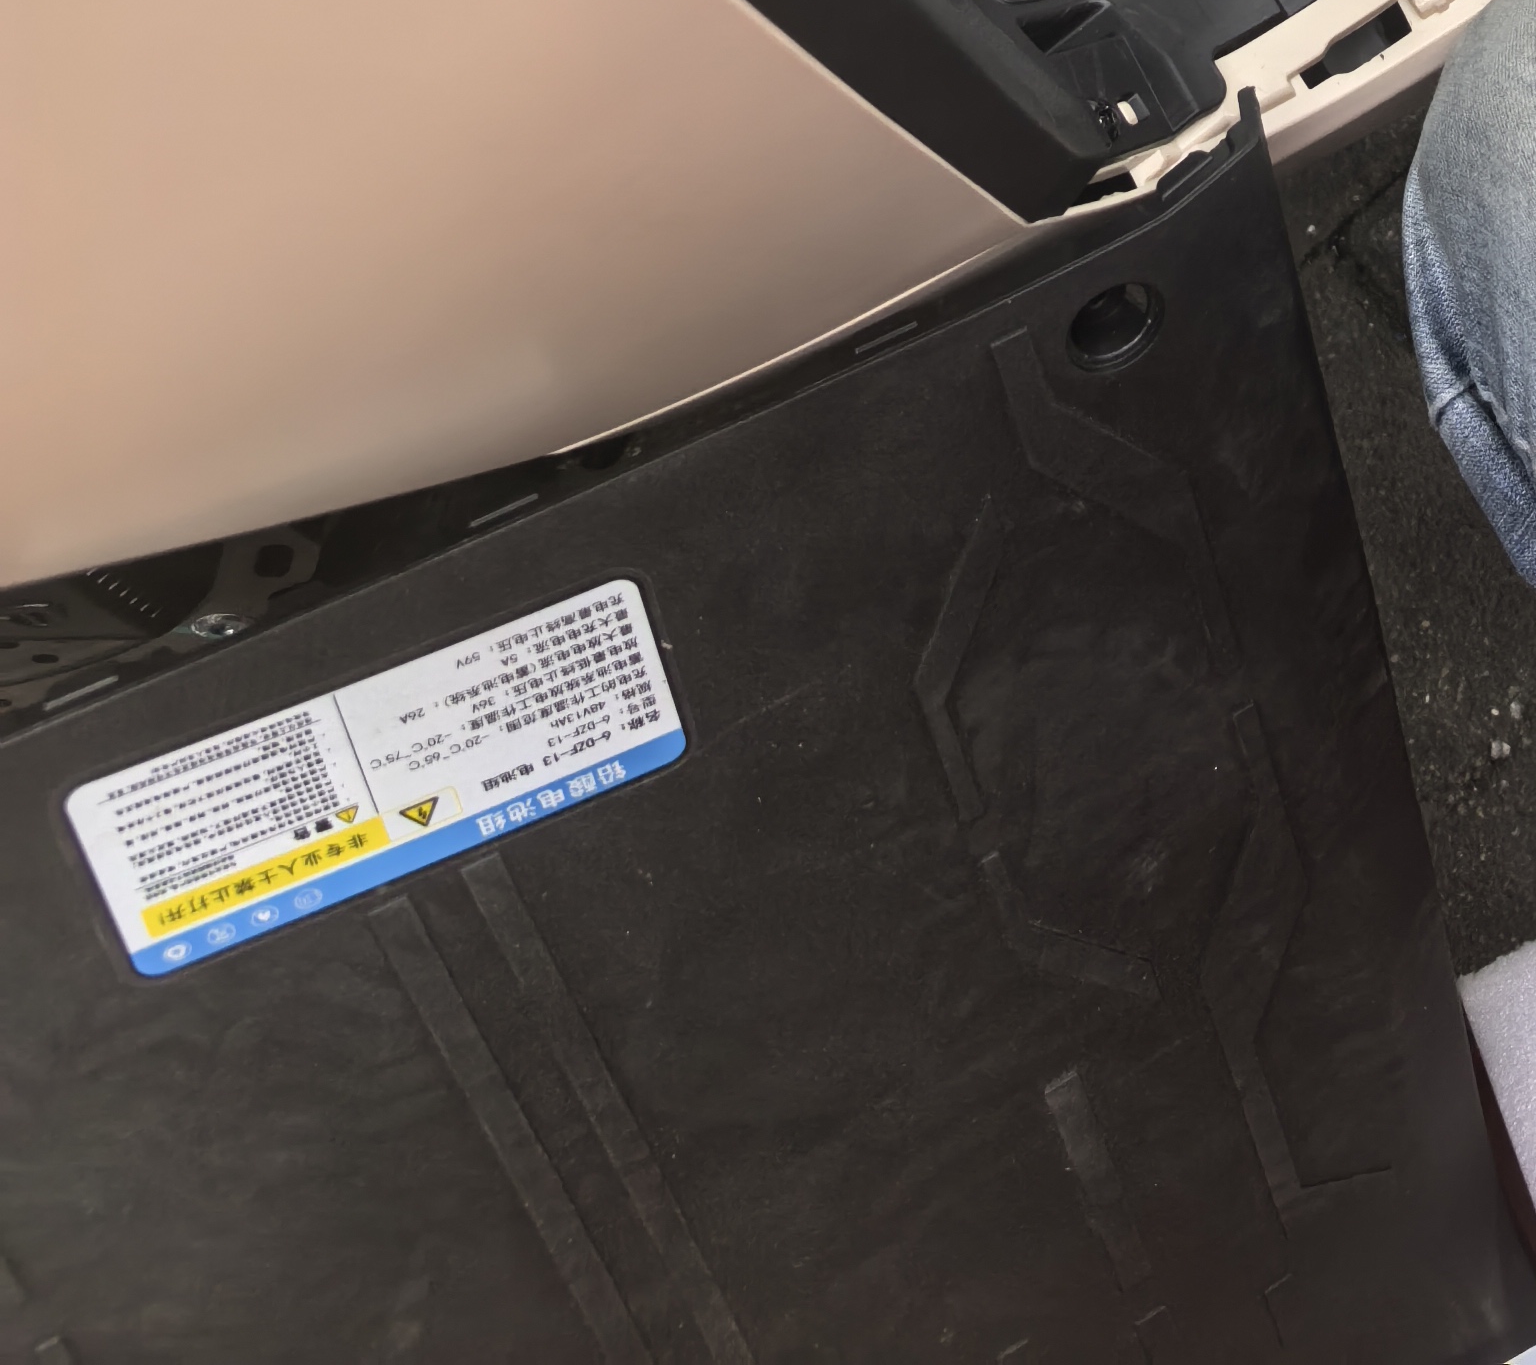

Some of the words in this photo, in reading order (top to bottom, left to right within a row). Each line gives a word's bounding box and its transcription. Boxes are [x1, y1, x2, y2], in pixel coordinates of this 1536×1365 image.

[475, 757, 626, 838] 铅酸电池组
[480, 760, 534, 792] 电池组
[155, 829, 369, 928] 非专业人士禁止打开!
